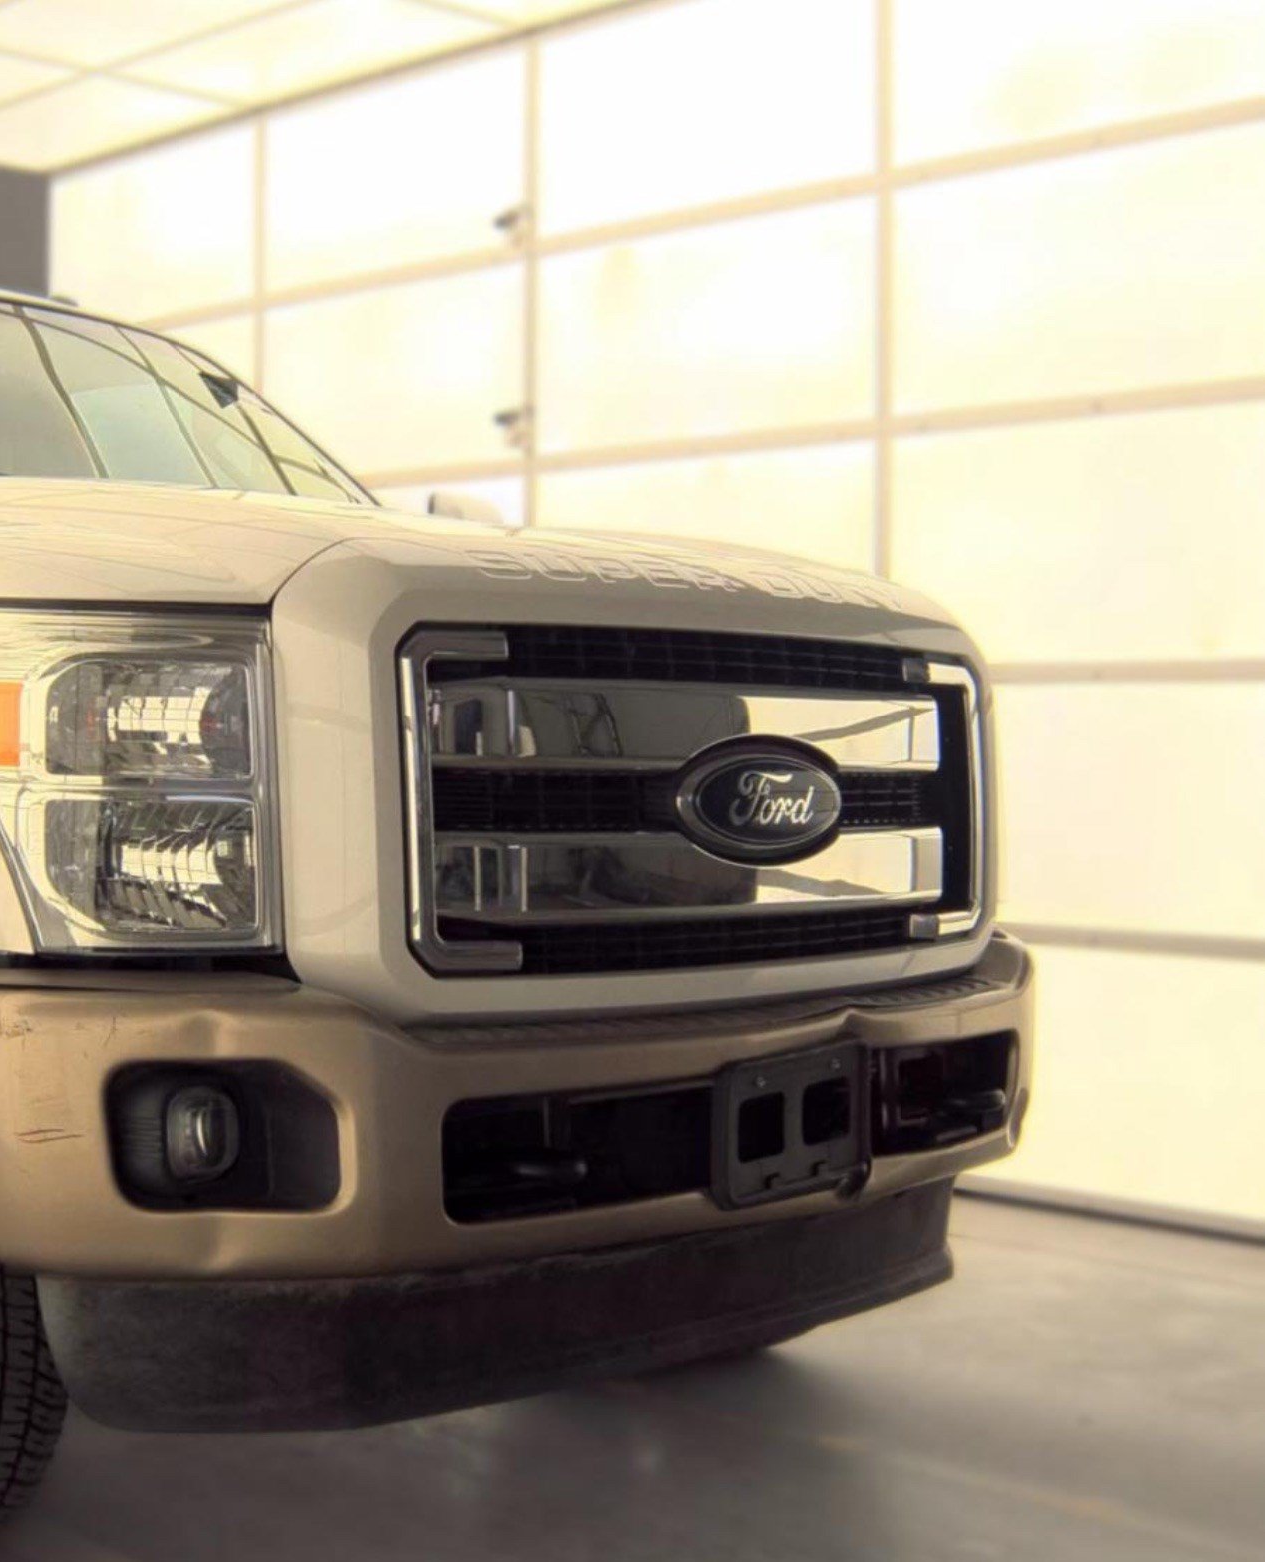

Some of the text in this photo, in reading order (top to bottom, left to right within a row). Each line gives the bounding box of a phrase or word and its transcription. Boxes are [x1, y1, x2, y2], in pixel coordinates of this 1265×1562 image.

[465, 548, 902, 611] SUPER DUTY
[728, 769, 815, 825] Ford
